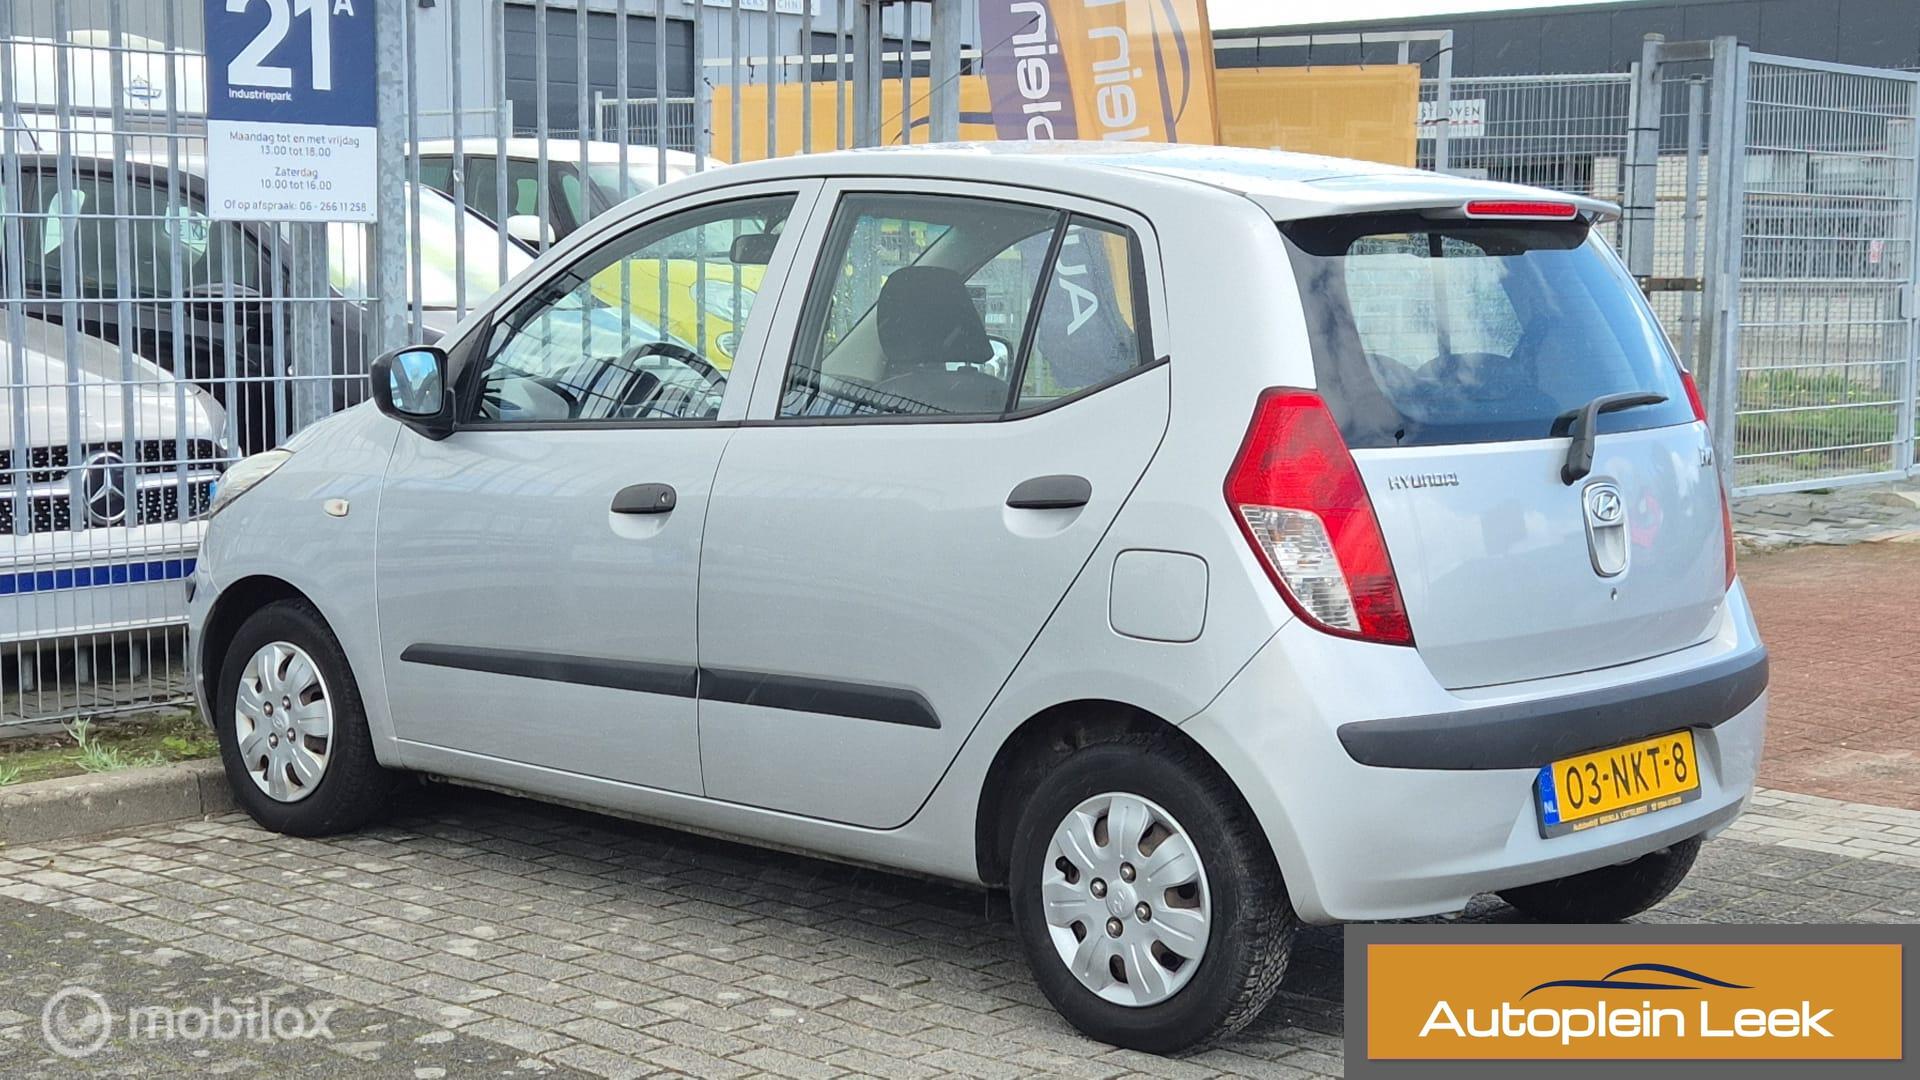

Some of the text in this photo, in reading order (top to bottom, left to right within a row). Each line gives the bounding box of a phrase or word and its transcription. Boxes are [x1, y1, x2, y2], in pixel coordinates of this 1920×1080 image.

[228, 88, 292, 102] Industriepark
[229, 131, 360, 148] Maandag tot en met vrijdag
[289, 146, 302, 156] tot
[274, 166, 318, 179] Zaterdag
[261, 179, 332, 191] 10.00 tot 16.00
[223, 199, 236, 210] Of
[238, 201, 251, 212] op
[299, 201, 313, 211] 06
[1387, 472, 1460, 491] HYUNDAI
[1543, 742, 1688, 814] NL 03-NKT-8
